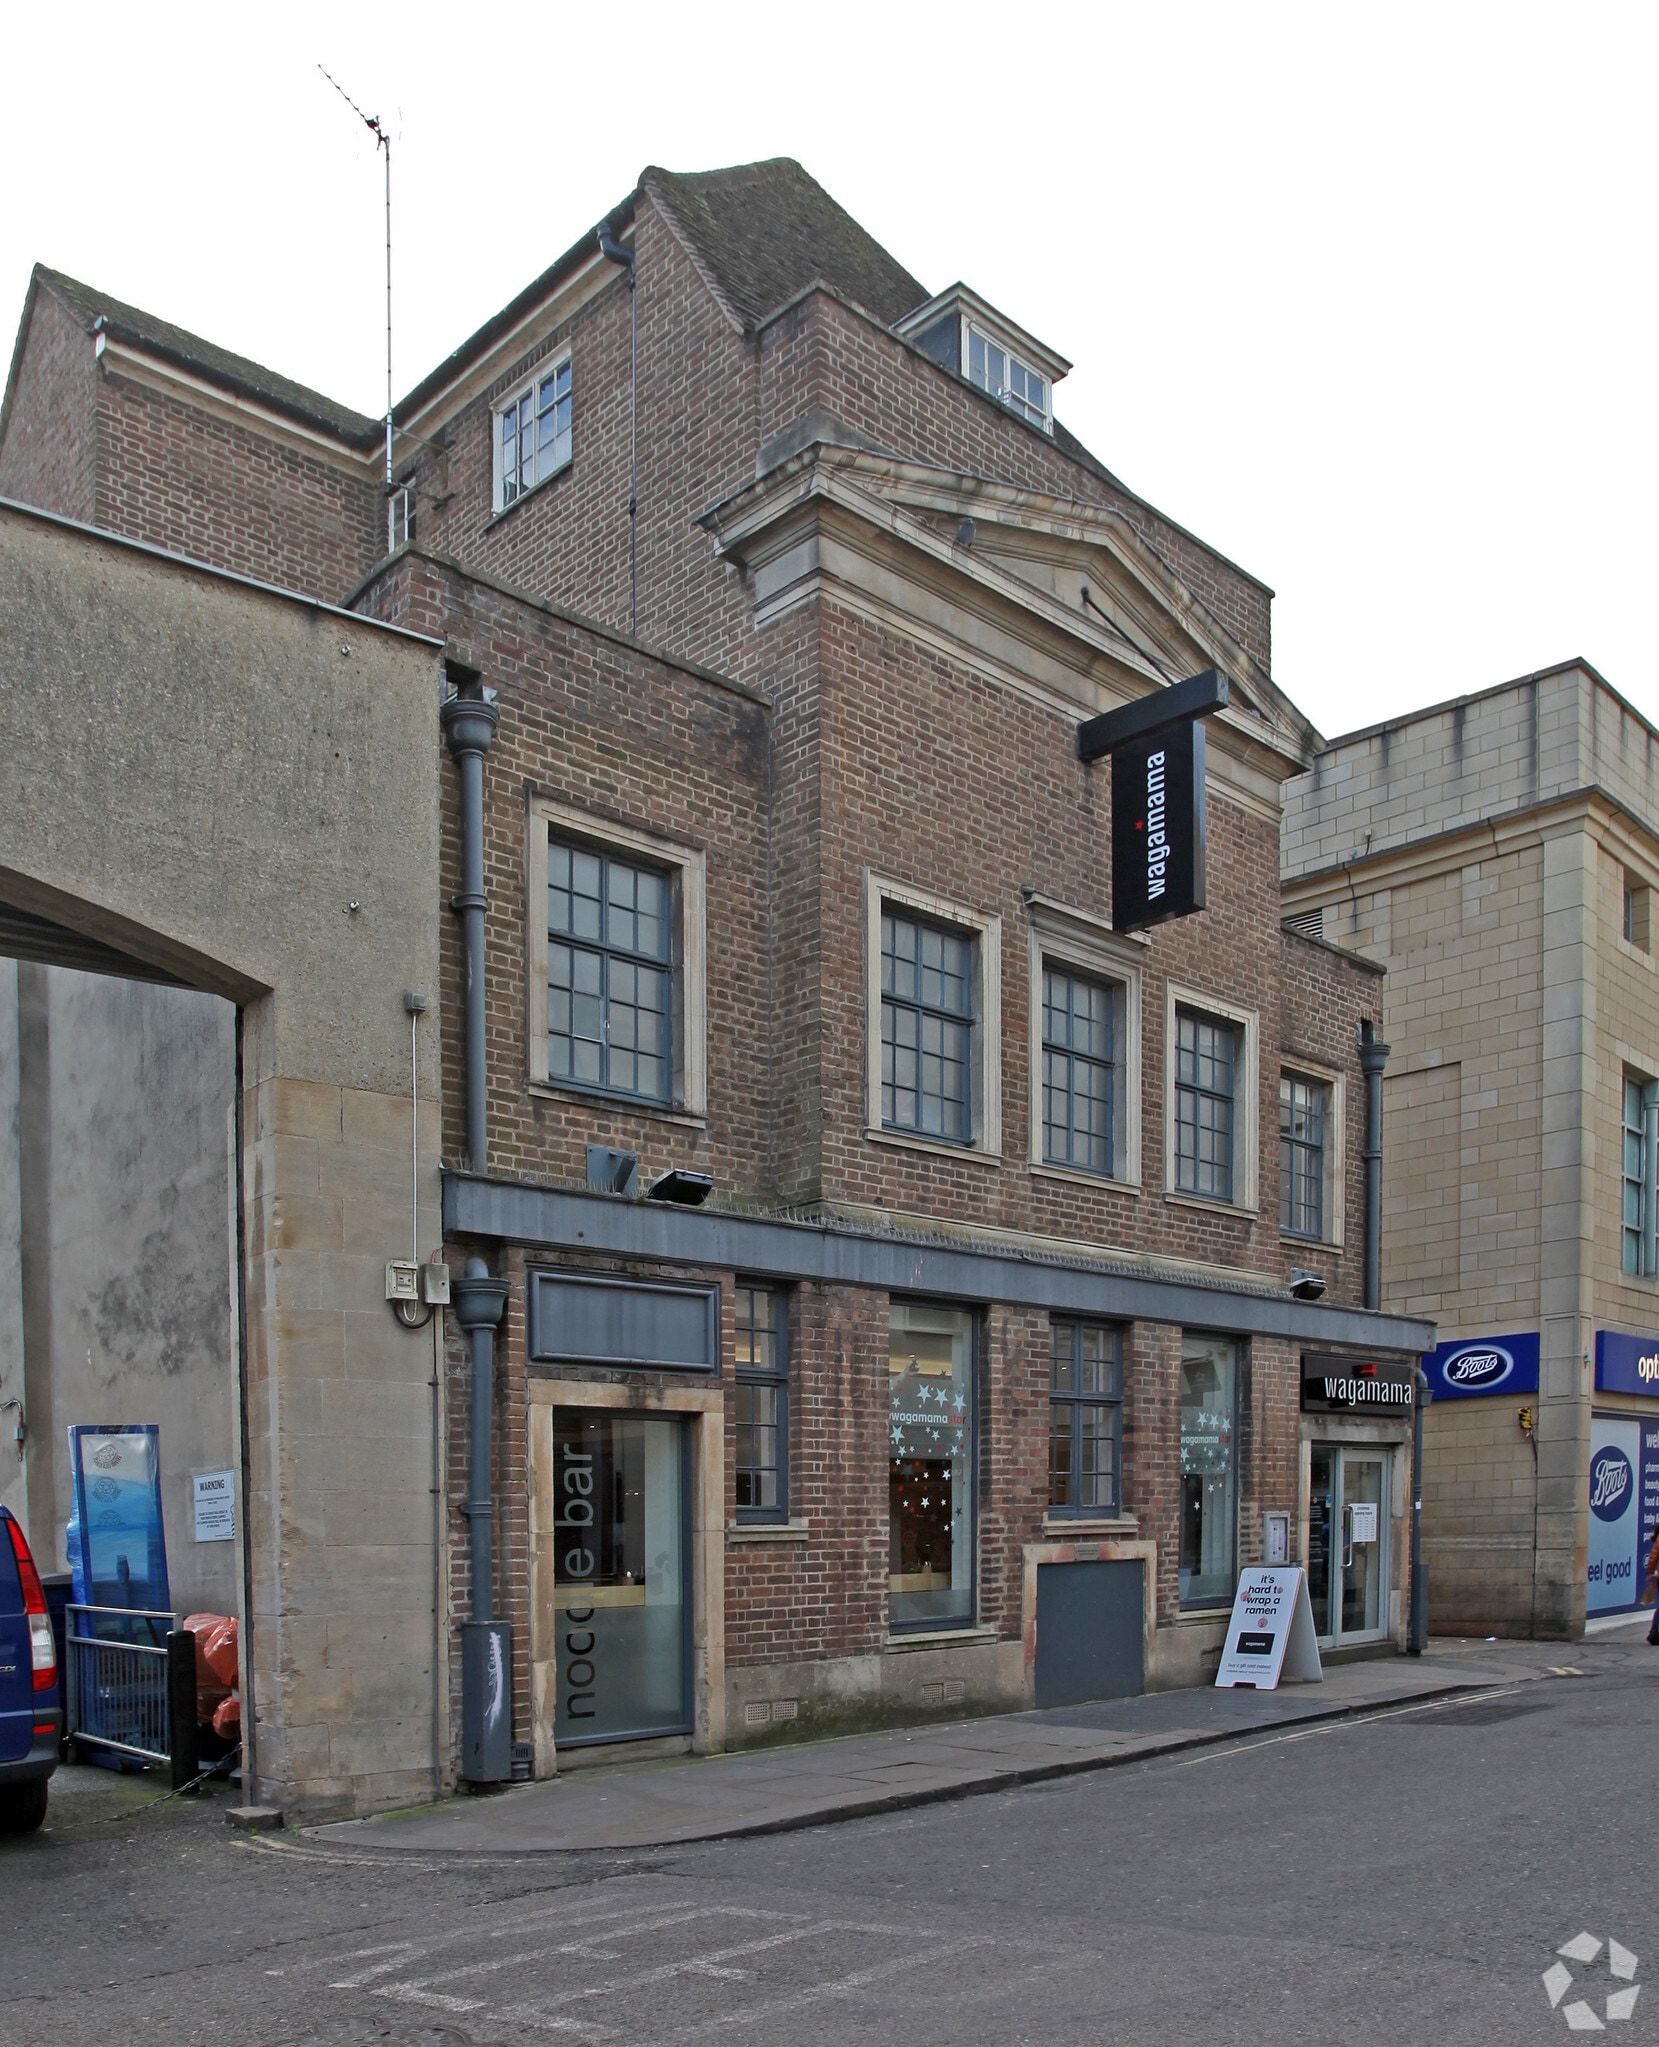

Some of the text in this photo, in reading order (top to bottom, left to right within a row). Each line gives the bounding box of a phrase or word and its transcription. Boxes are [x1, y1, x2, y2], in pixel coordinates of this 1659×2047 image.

[1147, 751, 1170, 900] wagamama
[1452, 1354, 1498, 1380] Boots
[1325, 1377, 1412, 1406] wagamama
[199, 1479, 225, 1492] WARNING
[555, 1443, 594, 1526] bar
[1590, 1459, 1628, 1506] Boots
[1587, 1555, 1632, 1584] eel good
[1246, 1597, 1281, 1606] wrap a
[1248, 1585, 1271, 1594] hard
[1245, 1607, 1277, 1615] ramen
